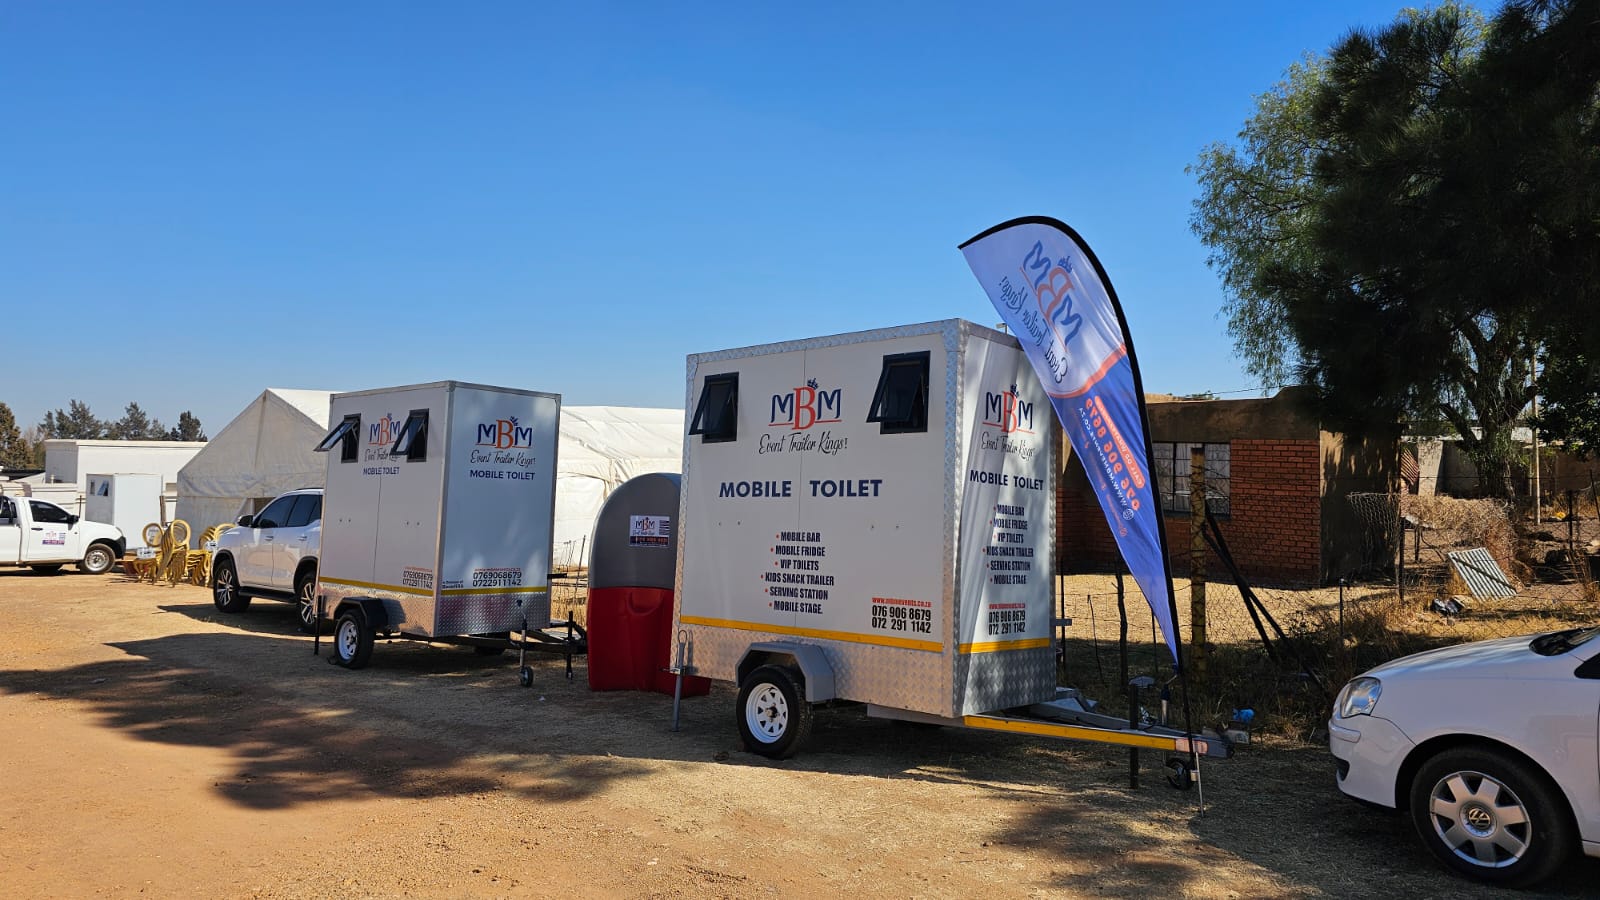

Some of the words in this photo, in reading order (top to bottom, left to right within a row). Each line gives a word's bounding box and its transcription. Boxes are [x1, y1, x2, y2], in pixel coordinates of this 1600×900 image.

[769, 387, 842, 430] MBM
[985, 391, 1034, 433] MBM
[369, 418, 400, 446] MBM
[477, 419, 533, 449] MBM
[759, 433, 785, 454] Event
[788, 432, 816, 452] Trailer
[817, 430, 848, 455] Kings!
[470, 450, 491, 463] Event
[494, 451, 514, 464] Trailer
[363, 467, 382, 475] MOBILE
[383, 466, 400, 475] TOILET
[470, 470, 503, 479] MOBILE
[506, 471, 535, 480] TOILET
[970, 469, 1008, 486] MOBILE
[1013, 475, 1044, 490] TOILET
[719, 480, 792, 498] MOBILE
[809, 479, 883, 497] TOILET
[997, 504, 1014, 516] MOBILE
[993, 518, 1010, 529] MOBILE
[781, 532, 805, 542] MOBILE
[806, 532, 820, 543] BAR
[997, 532, 1006, 542] VIP
[1006, 533, 1024, 543] TOILETS
[775, 545, 800, 556] MOBILE
[801, 546, 825, 557] FRIDGE
[780, 559, 792, 569] VIP
[793, 559, 819, 570] TOILETS
[991, 560, 1011, 571] SERVING
[473, 571, 522, 579] 0769068679
[765, 572, 781, 583] KIDS
[782, 573, 805, 584] SNACK
[806, 575, 834, 586] TRAILER
[994, 575, 1012, 584] MOBILE
[472, 579, 521, 587] 0722911142
[770, 586, 798, 598] SERVING
[800, 588, 828, 600] STATION
[774, 601, 798, 612] MOBILE
[799, 603, 823, 614] STAGE.
[872, 605, 888, 618] 076
[889, 606, 906, 619] 906
[909, 608, 931, 622] 8679
[989, 612, 999, 623] 076
[872, 616, 887, 629] 072
[891, 619, 907, 631] 291
[912, 620, 931, 633] 1142
[989, 624, 998, 635] 072
[1001, 623, 1011, 634] 291
